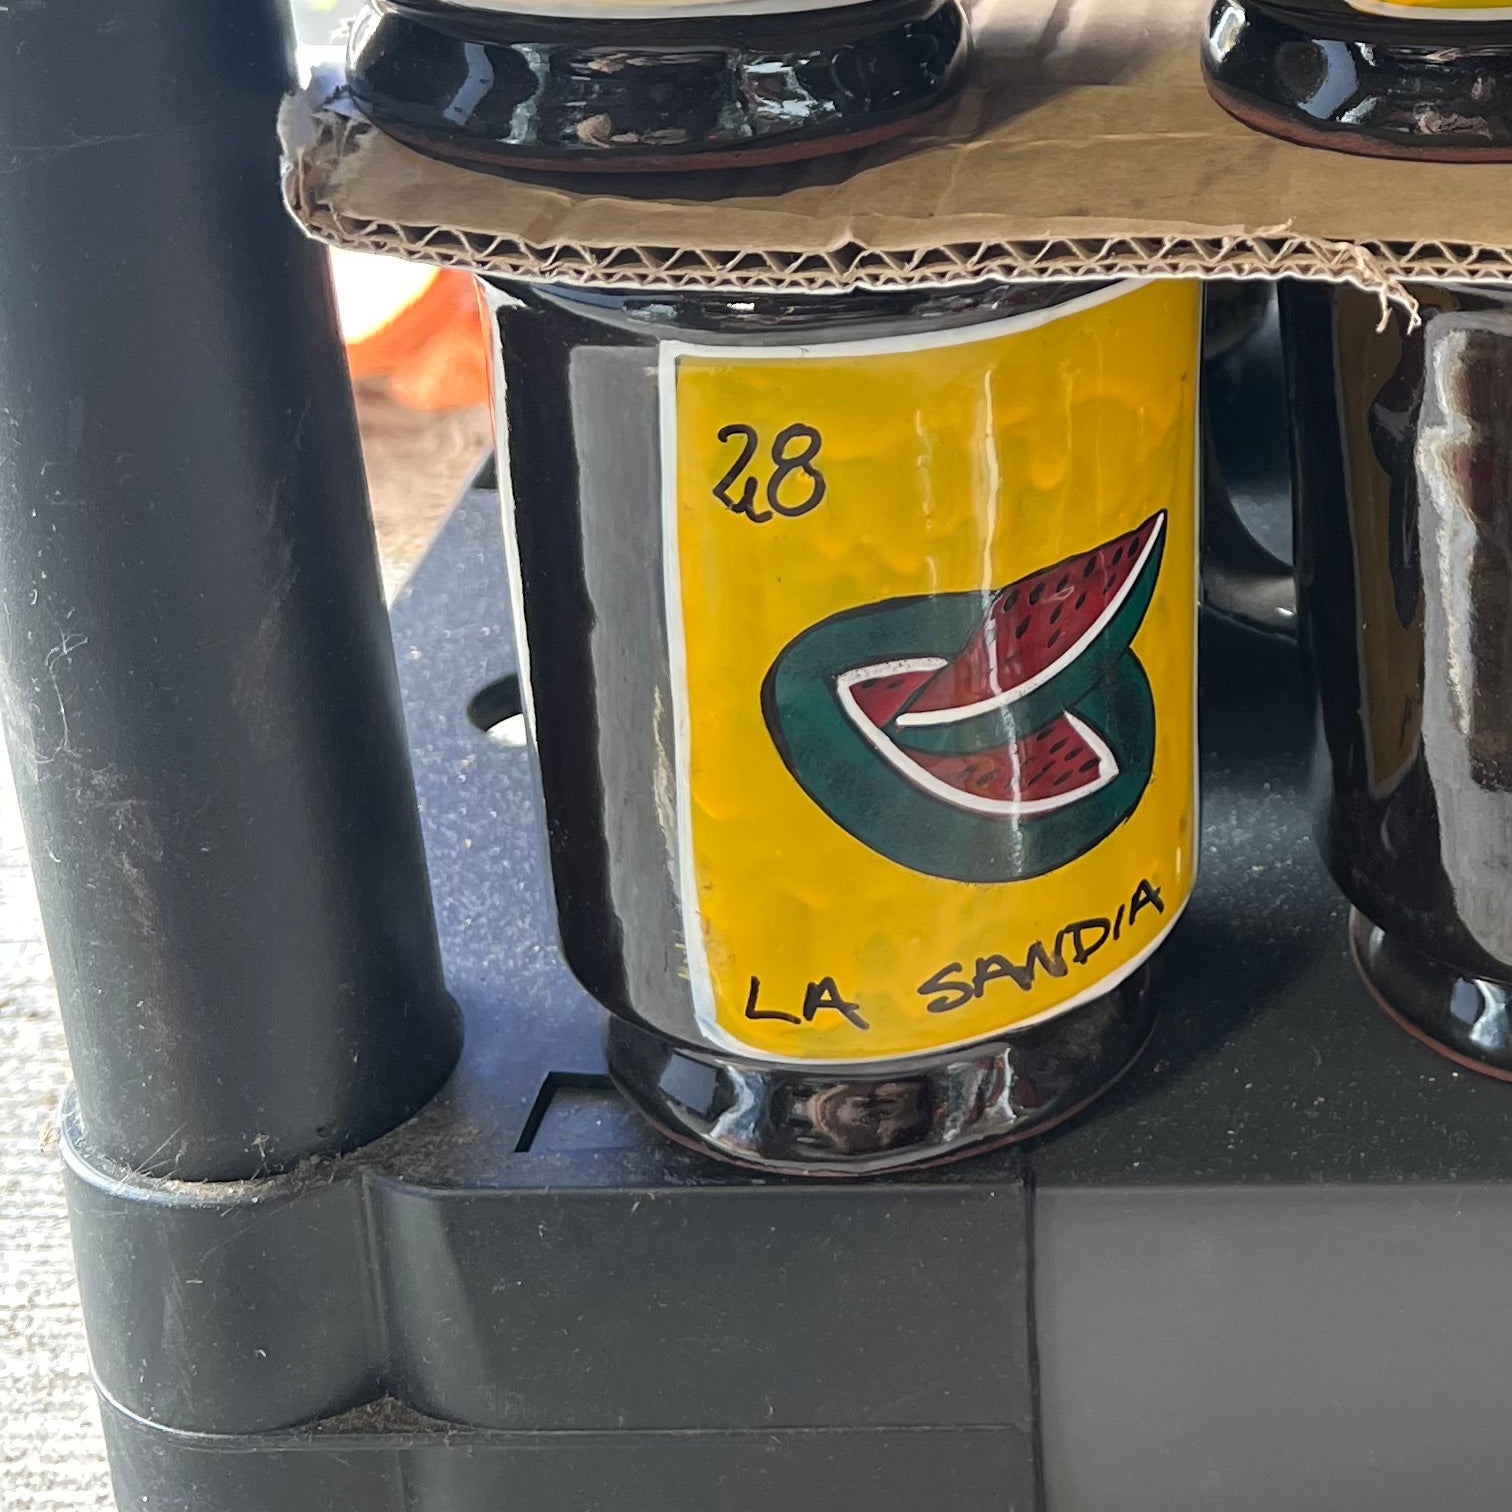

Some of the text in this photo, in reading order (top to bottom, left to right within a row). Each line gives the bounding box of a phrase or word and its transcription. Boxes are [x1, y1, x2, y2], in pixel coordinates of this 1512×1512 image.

[711, 422, 827, 524] 28
[744, 878, 1166, 1031] LA SANDIA
